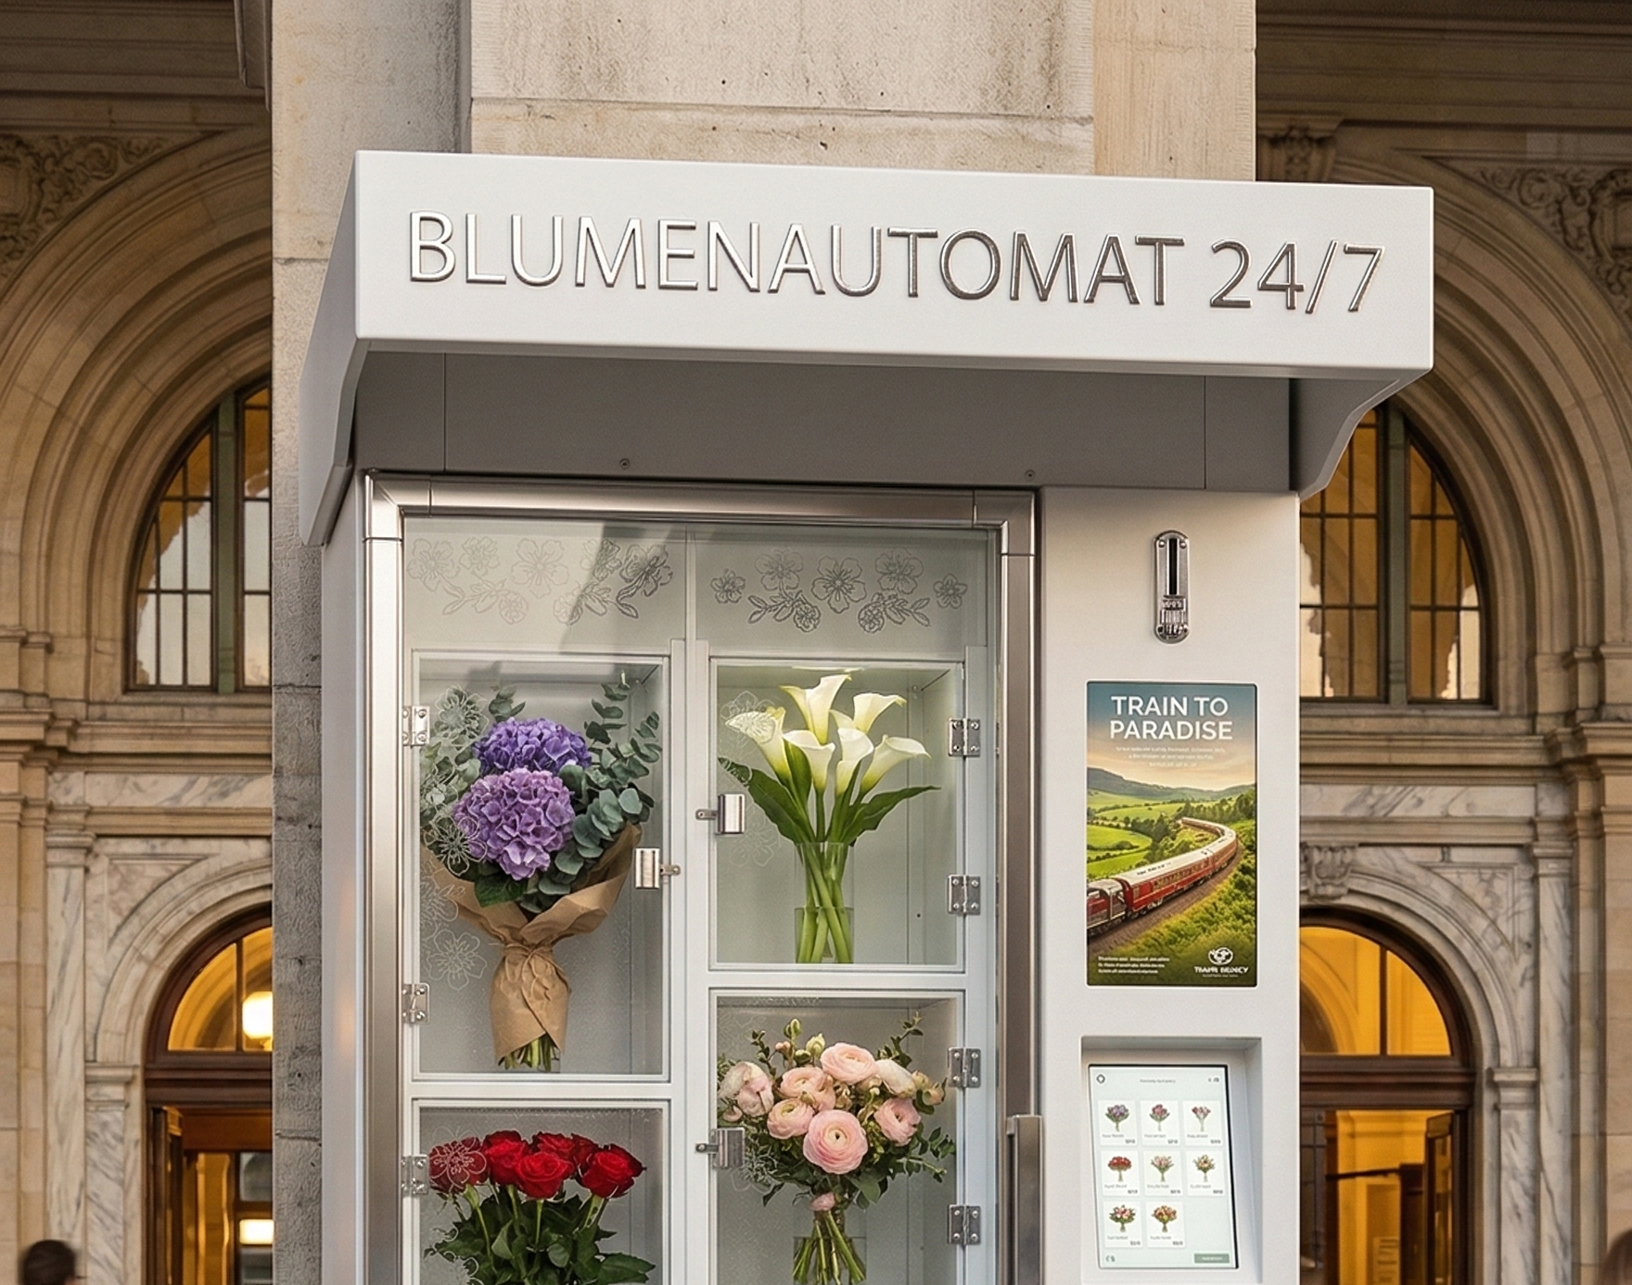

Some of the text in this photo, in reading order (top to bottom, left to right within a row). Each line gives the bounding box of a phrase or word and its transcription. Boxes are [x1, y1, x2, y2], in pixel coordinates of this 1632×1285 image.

[408, 211, 1385, 315] BLUMENAUTOMAT 24/7
[1110, 695, 1229, 716] TRAIN TO
[1109, 720, 1233, 741] PARADISE
